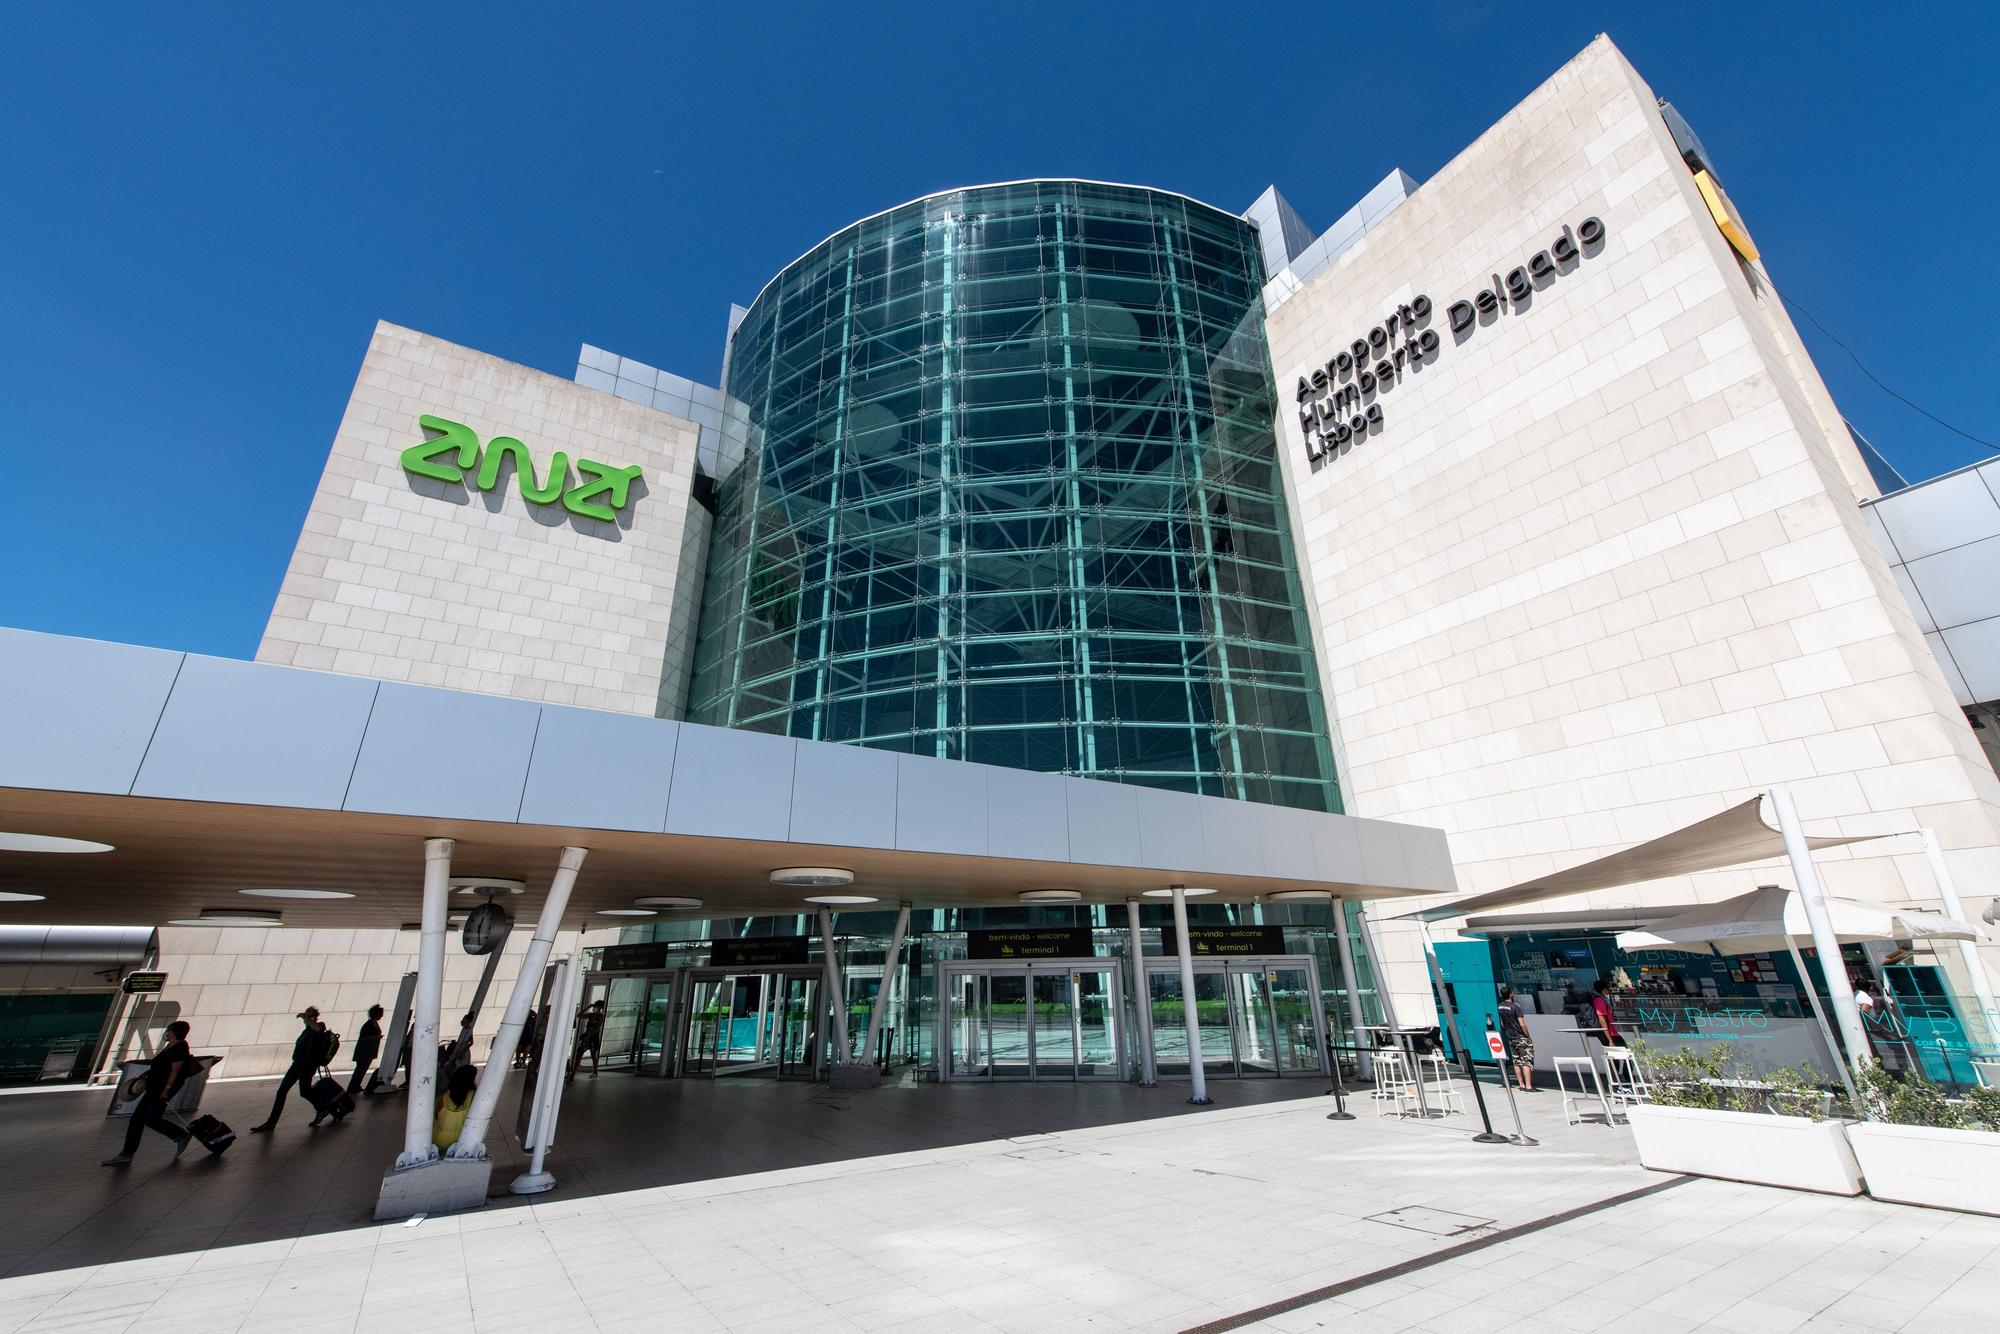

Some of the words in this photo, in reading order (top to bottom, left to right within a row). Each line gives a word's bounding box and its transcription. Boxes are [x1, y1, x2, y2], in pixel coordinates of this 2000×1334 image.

[1299, 329, 1440, 434] Humberto
[1447, 216, 1606, 334] Delgado
[1296, 294, 1432, 403] Aeroporto
[1305, 403, 1384, 463] Lisboa
[988, 933, 1030, 941] bem-vindo
[1037, 932, 1070, 940] welcome
[1188, 930, 1224, 938] em-vindo
[1021, 946, 1054, 954] terminal
[1612, 948, 1639, 964] My
[1639, 1008, 1676, 1030] My
[1684, 1007, 1768, 1028] Bistro
[1860, 1009, 1913, 1037] My
